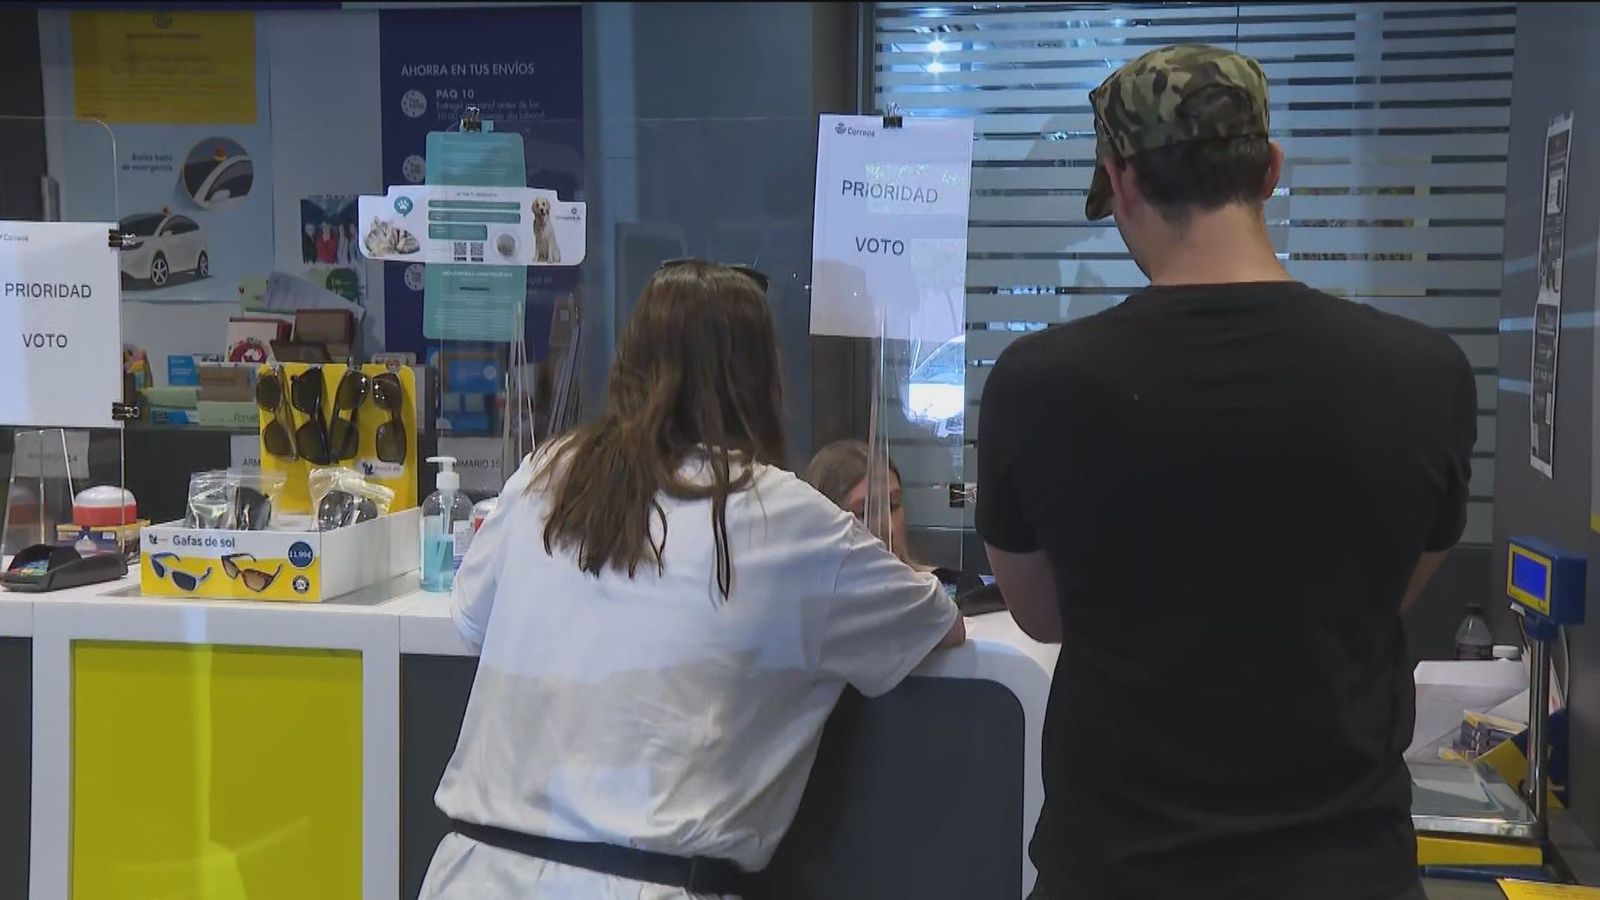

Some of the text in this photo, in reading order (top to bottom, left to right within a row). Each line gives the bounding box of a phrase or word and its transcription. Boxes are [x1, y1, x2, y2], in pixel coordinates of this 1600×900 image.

[401, 60, 535, 77] AHORRA EN TUS ENVÍOS
[436, 89, 475, 99] PAQ 10
[847, 126, 875, 138] Correos
[841, 179, 939, 204] PRIORIDAD
[855, 236, 905, 256] VOTO
[4, 282, 92, 299] PRIORIDAD
[22, 333, 68, 348] VOTO
[172, 534, 236, 548] Gafas de sol
